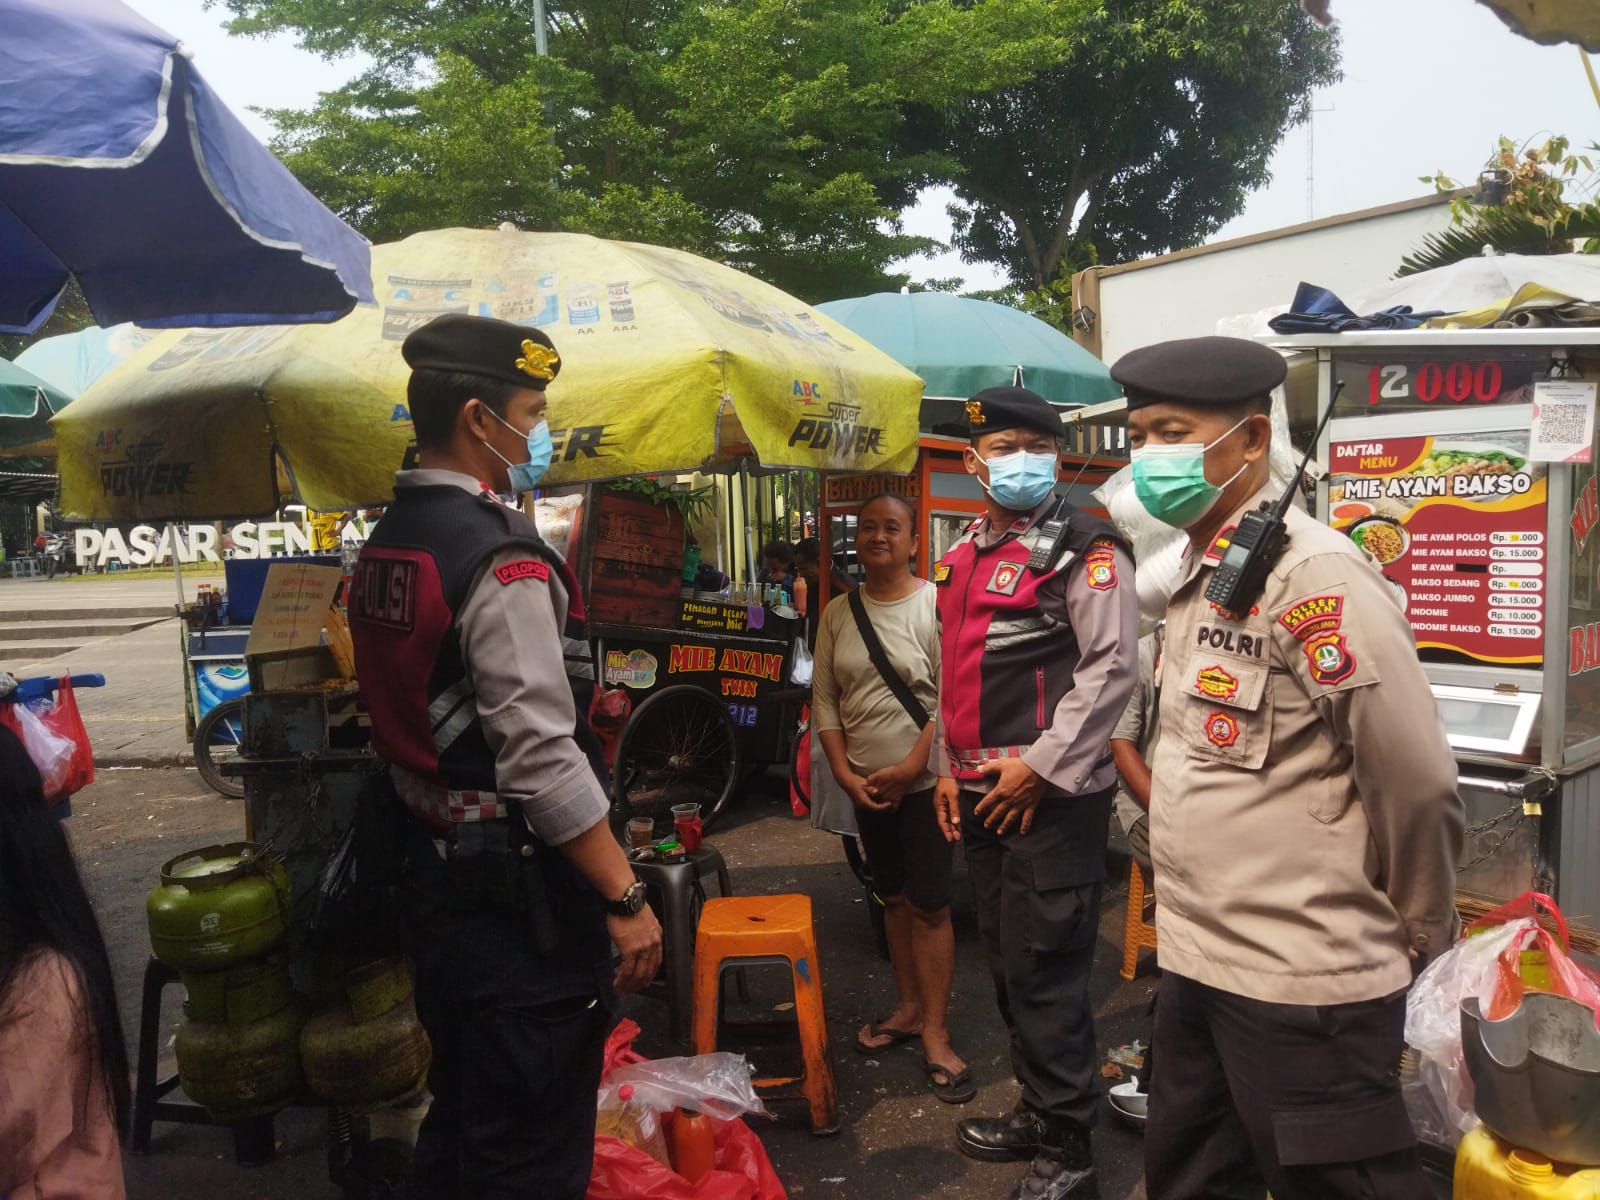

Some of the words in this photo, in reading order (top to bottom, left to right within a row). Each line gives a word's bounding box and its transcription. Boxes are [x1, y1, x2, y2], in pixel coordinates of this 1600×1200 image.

[578, 328, 594, 336] AA
[793, 379, 821, 399] ABC
[826, 402, 862, 424] Super
[788, 419, 886, 457] POWER
[1336, 443, 1383, 458] DAFTAR
[1359, 456, 1398, 470] MENU
[101, 463, 193, 498] POWER
[1344, 478, 1382, 499] MIE
[1386, 476, 1446, 498] AYAM
[1453, 472, 1532, 495] BAKSO
[1412, 533, 1428, 541] MIE
[1430, 533, 1454, 541] AYAM
[1456, 533, 1487, 542] POLOS
[1493, 534, 1507, 542] Rp.
[75, 524, 221, 567] PASAR
[1456, 549, 1487, 557] BAKSO
[1492, 550, 1507, 558] Rp.
[1429, 564, 1453, 572] AYAM
[1492, 565, 1507, 573] Rp.
[1411, 578, 1442, 586] BAKSO
[1443, 579, 1480, 588] SEDANG
[1492, 581, 1506, 589] Rp.
[1411, 593, 1441, 601] BAKSO
[1443, 594, 1475, 603] JUMBO
[1491, 596, 1506, 604] Rp.
[1284, 598, 1337, 623] POLSEK
[1410, 608, 1448, 616] INDOMIE
[1490, 611, 1505, 620] Rp.
[1508, 611, 1536, 620] 10.000
[1410, 622, 1448, 631] INDOMIE
[1450, 624, 1481, 633] BAKSO
[1490, 627, 1505, 635] Rp.
[1508, 627, 1536, 635] 15.000
[1197, 626, 1263, 658] POLRI
[607, 652, 627, 668] Mie
[668, 644, 716, 673] MIE
[719, 648, 783, 682] AYAM
[606, 669, 634, 681] Ayam
